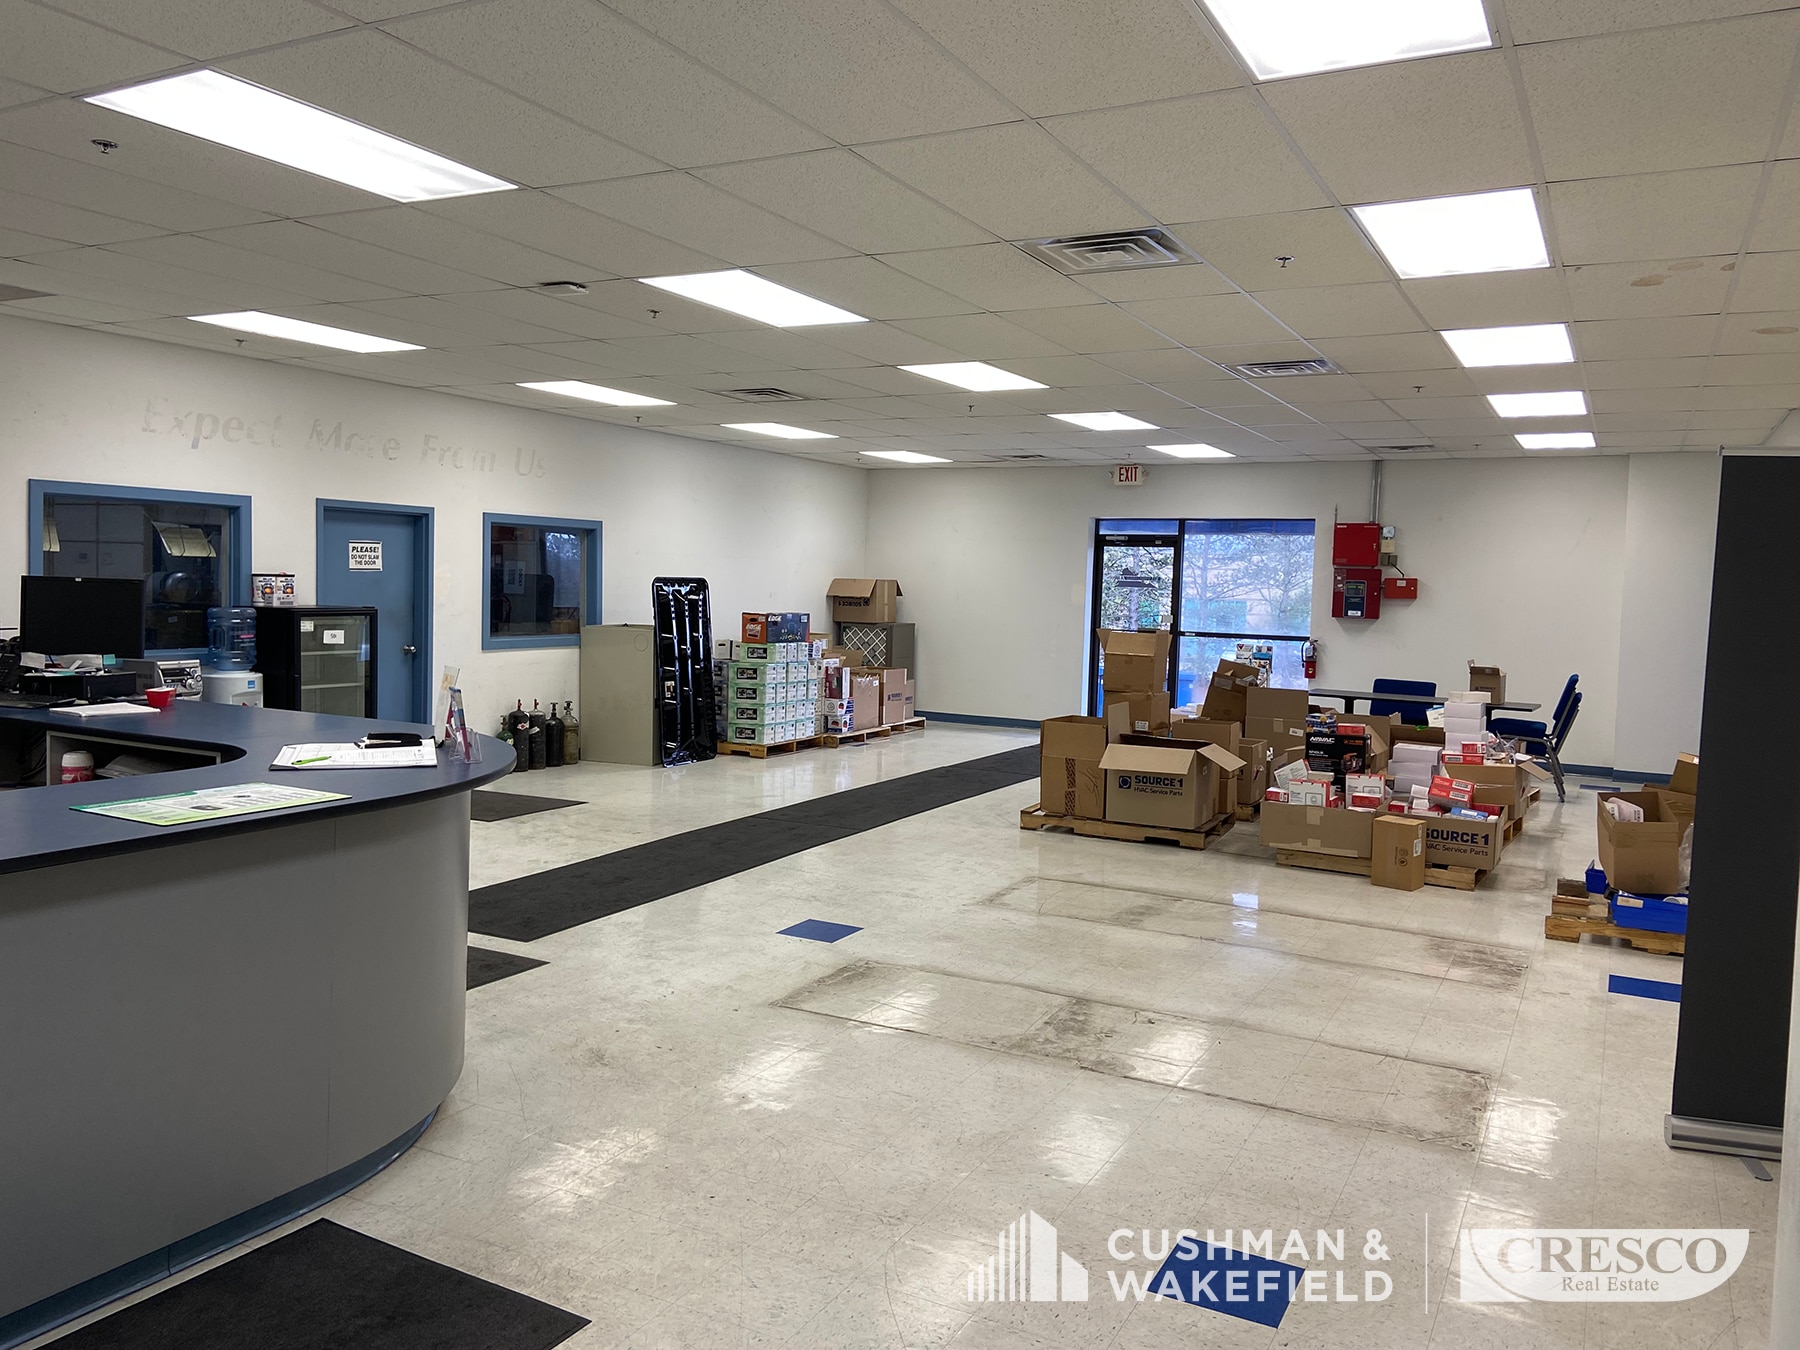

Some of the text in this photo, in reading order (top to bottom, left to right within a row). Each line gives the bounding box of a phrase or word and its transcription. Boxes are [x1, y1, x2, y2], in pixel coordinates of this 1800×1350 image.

[1119, 466, 1139, 482] EXIT
[1134, 775, 1184, 788] SOURCE 1
[1169, 789, 1183, 797] Parts
[1481, 833, 1489, 846] 1
[1426, 842, 1489, 857] VAC Service Parts
